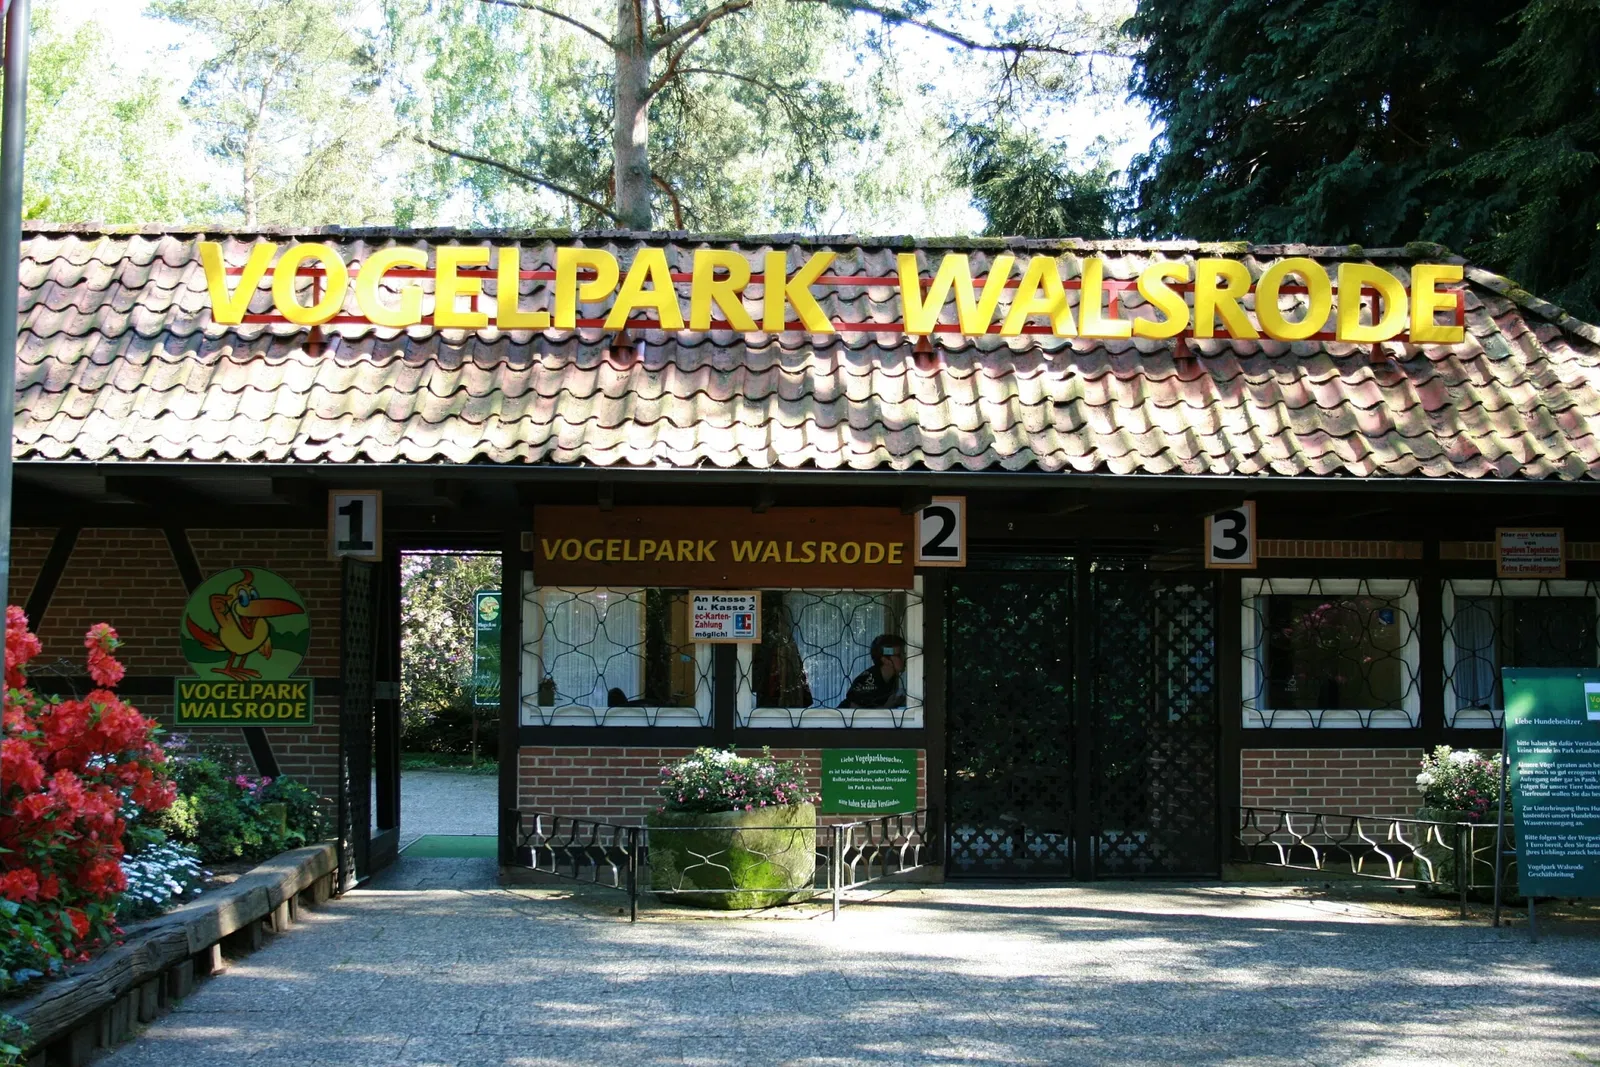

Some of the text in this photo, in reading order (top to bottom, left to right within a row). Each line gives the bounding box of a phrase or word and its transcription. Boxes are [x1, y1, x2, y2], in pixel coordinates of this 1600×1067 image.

[199, 241, 1464, 344] VOGELPARK WALSRODE
[338, 500, 373, 550] 1
[922, 506, 958, 556] 2
[1214, 510, 1248, 559] 3
[540, 538, 904, 564] VOGELPARK WALSRODE
[695, 621, 723, 630] Zahlung
[180, 683, 307, 700] VOGELPARK
[180, 702, 307, 719] WALSRODE
[855, 754, 904, 764] Vogelparkbesucher,
